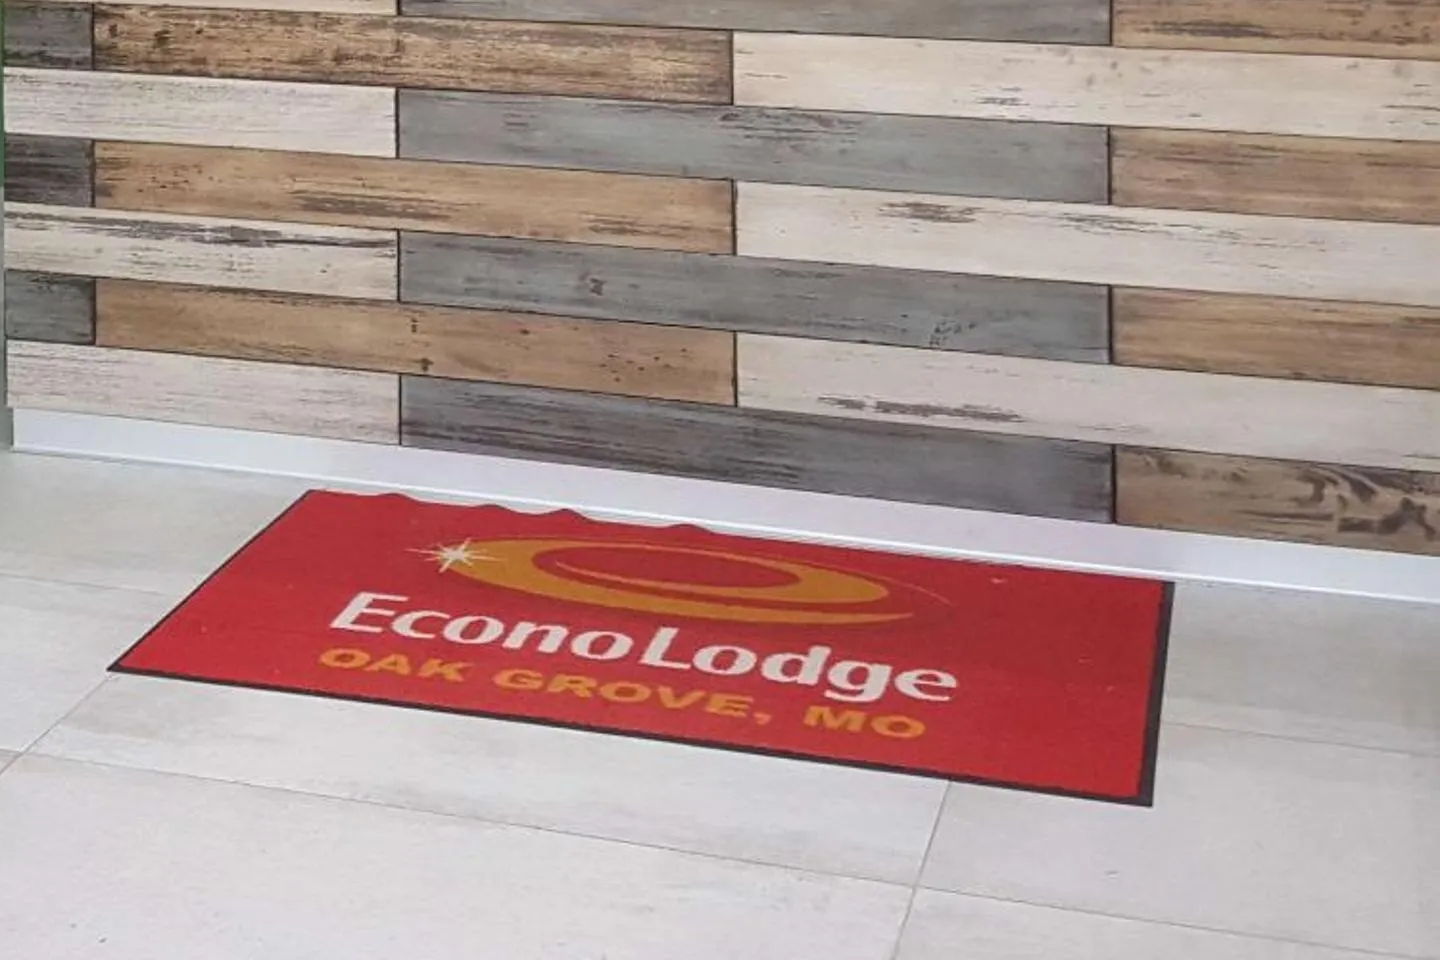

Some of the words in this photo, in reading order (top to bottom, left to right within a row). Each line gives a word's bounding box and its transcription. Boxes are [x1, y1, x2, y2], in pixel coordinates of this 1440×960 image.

[317, 646, 467, 684] OAK
[493, 667, 773, 727] GROVE,
[802, 704, 928, 741] MO
